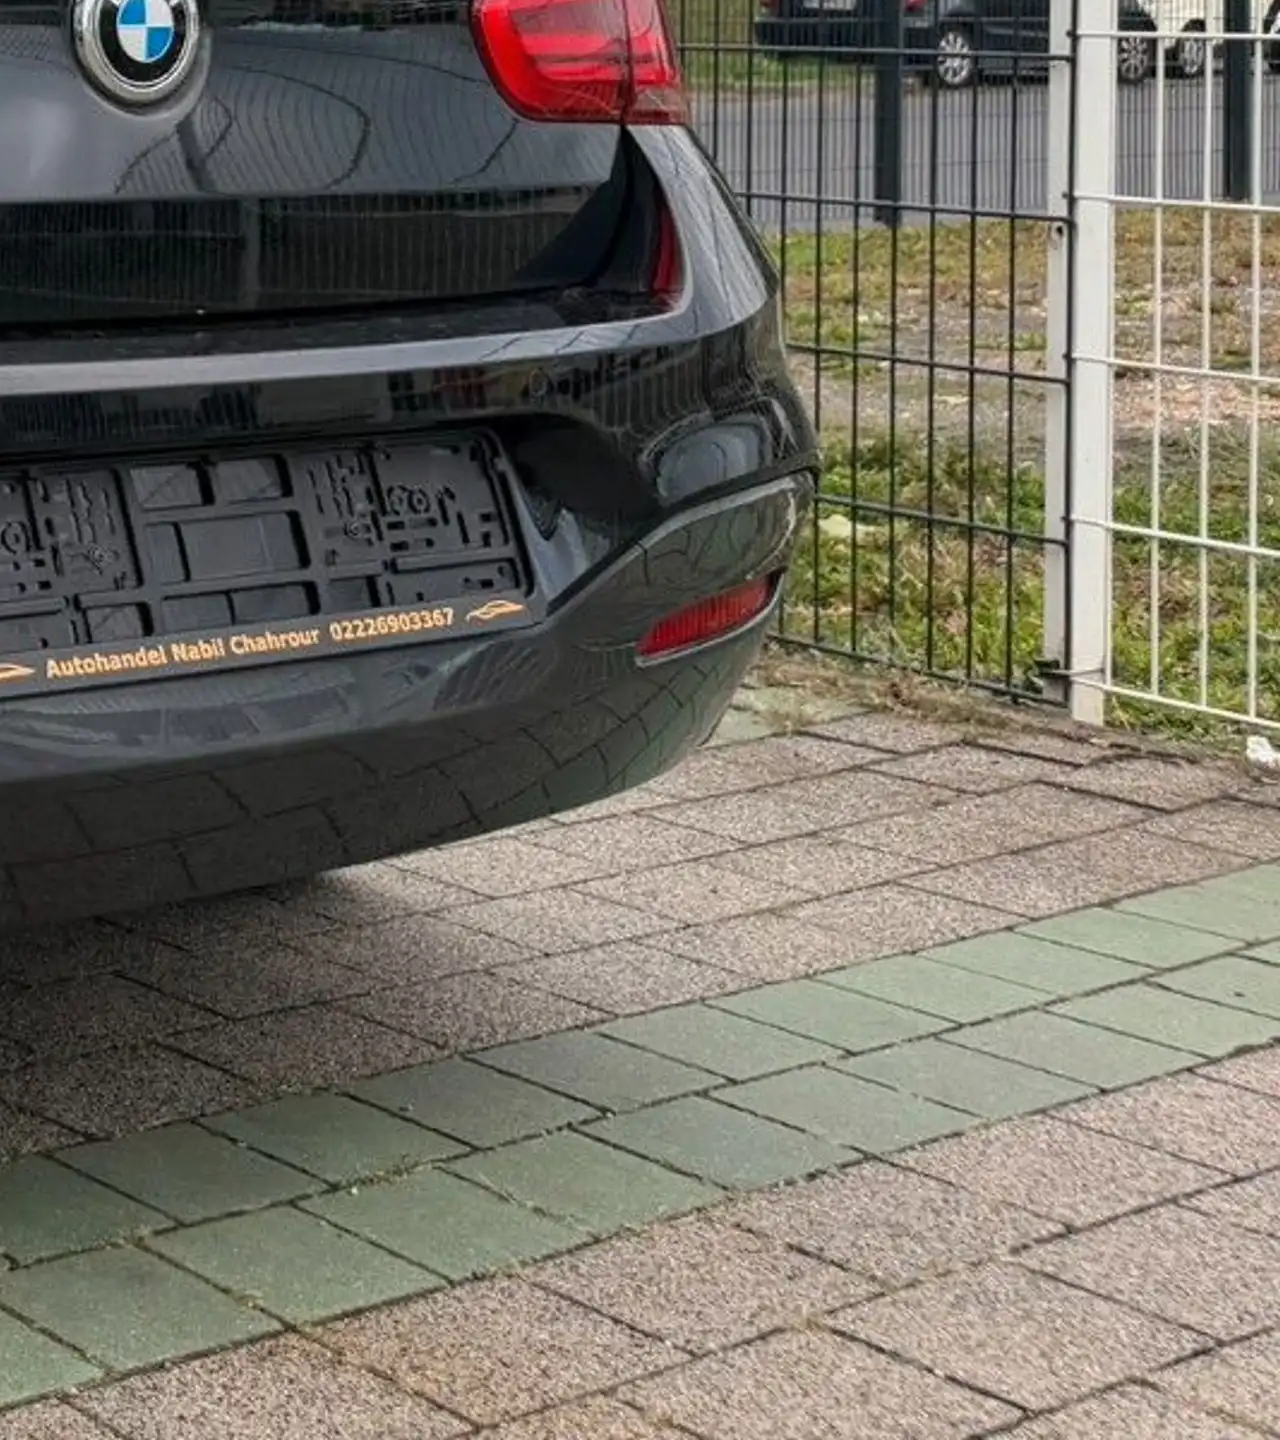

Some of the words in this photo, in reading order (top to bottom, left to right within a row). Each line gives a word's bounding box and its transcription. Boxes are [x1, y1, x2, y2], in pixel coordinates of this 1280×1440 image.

[46, 645, 168, 679] Autohandel
[171, 637, 226, 662] Nabil
[229, 628, 321, 655] Chahrour
[328, 607, 454, 641] 02226903367
